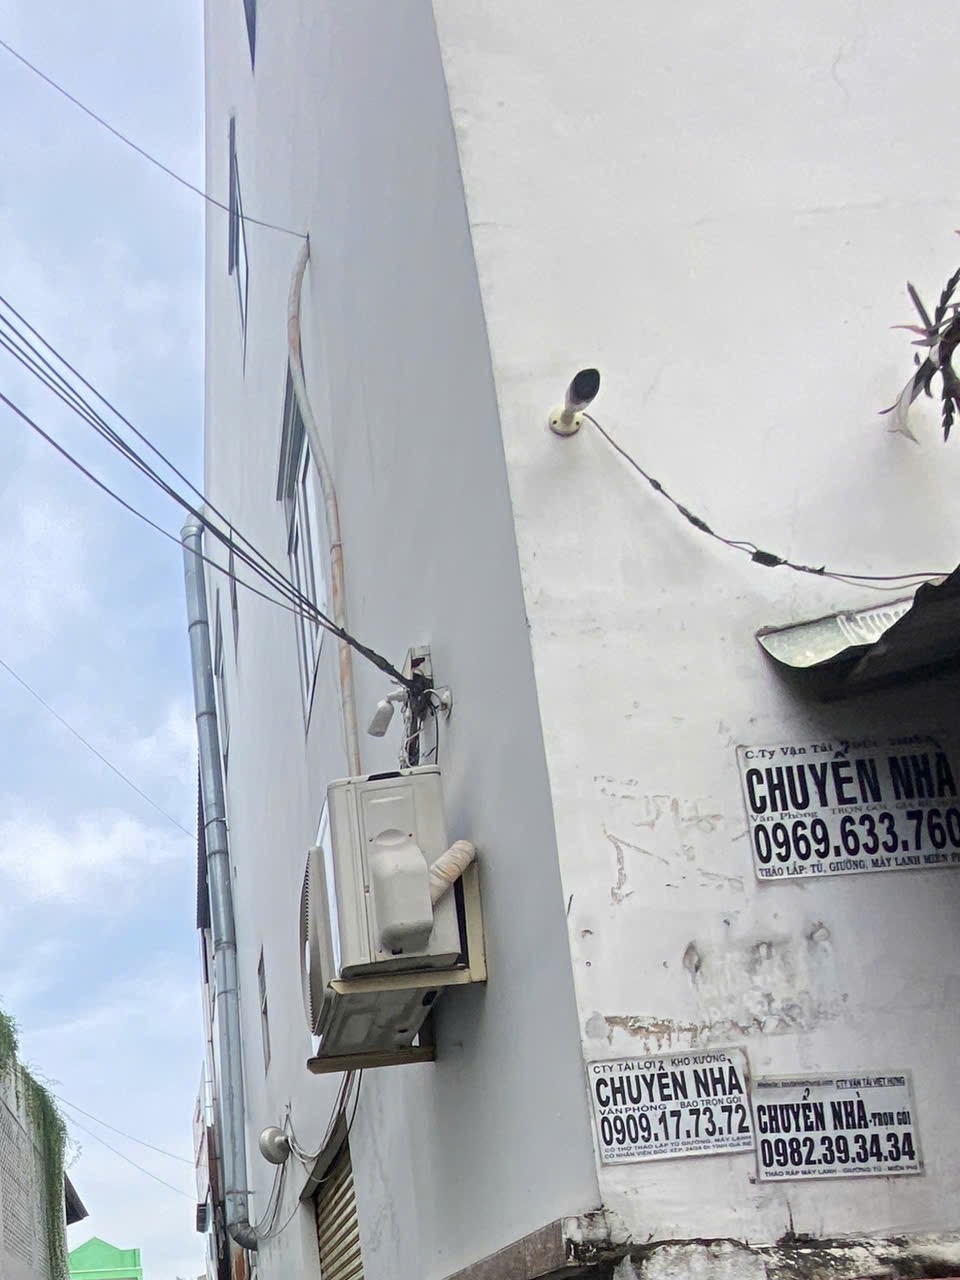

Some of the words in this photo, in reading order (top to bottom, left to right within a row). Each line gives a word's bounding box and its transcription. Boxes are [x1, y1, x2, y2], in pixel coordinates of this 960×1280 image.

[745, 741, 882, 814] CHUYỂN
[753, 807, 960, 864] 0969.633.760
[759, 865, 784, 878] THÁO
[593, 1063, 615, 1074] CTY
[671, 1057, 690, 1067] KHO
[595, 1060, 688, 1107] CHUYỂN
[692, 1058, 744, 1098] NHÀ
[601, 1103, 750, 1146] 0909.17.73.72
[757, 1088, 826, 1134] CHUYỂN
[760, 1132, 915, 1168] 0982.39.34.34
